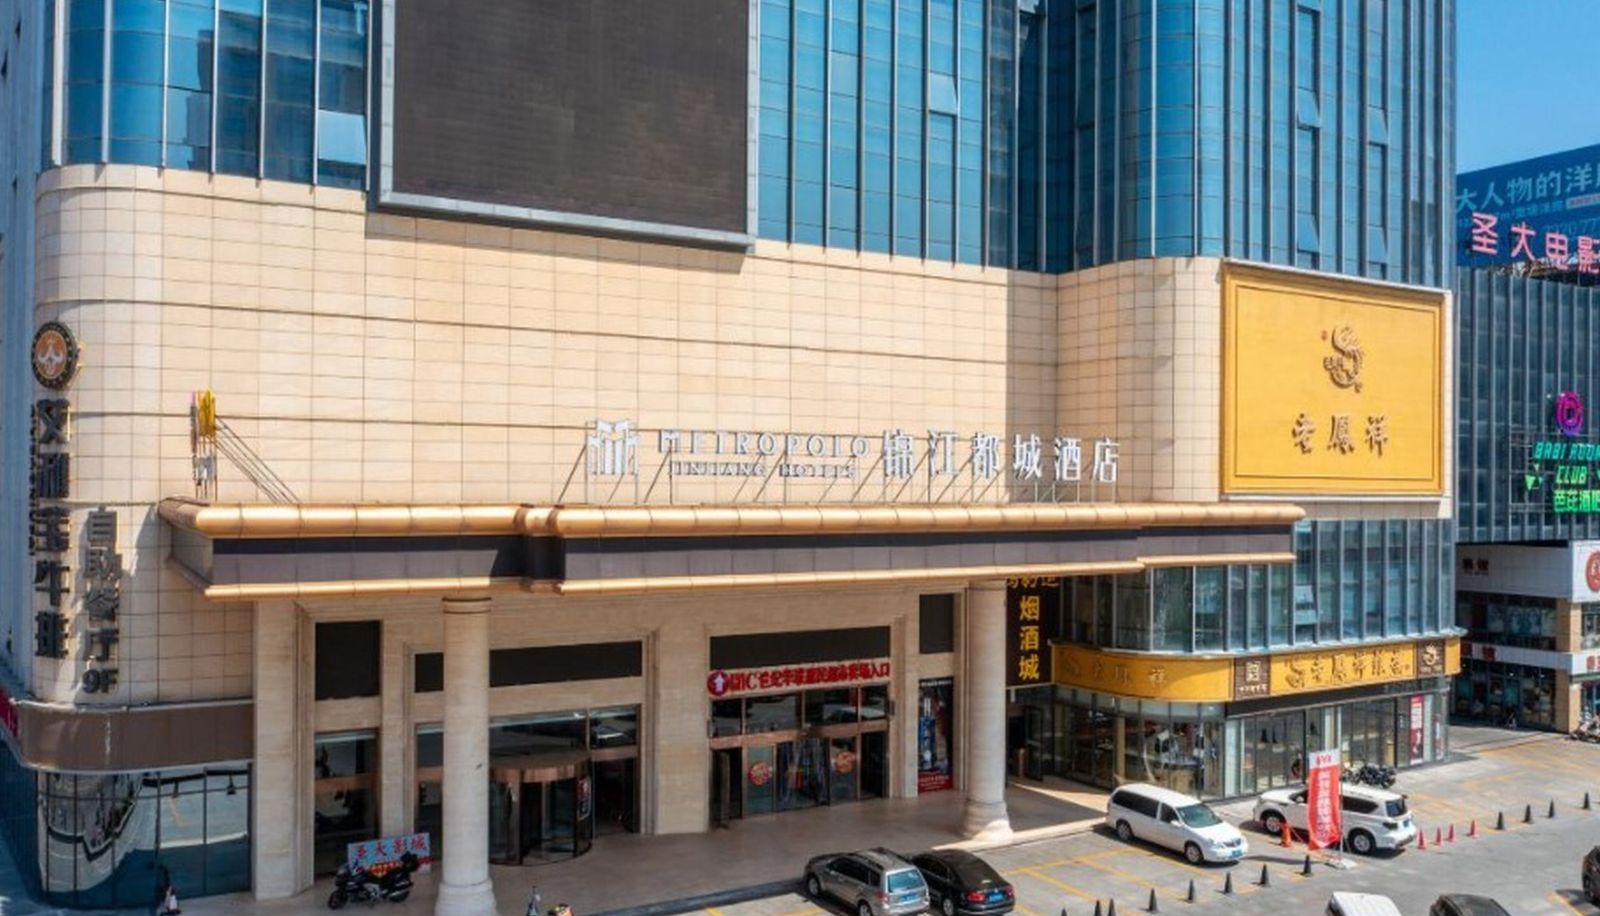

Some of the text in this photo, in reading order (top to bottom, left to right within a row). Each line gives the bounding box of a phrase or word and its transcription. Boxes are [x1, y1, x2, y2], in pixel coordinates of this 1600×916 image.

[1456, 163, 1600, 213] 大人物的洋
[659, 428, 870, 458] METROPOLO
[883, 429, 1121, 483] 锦江都城酒店
[670, 460, 859, 479] JINJIANG HOTELS
[1555, 465, 1588, 485] CLUB
